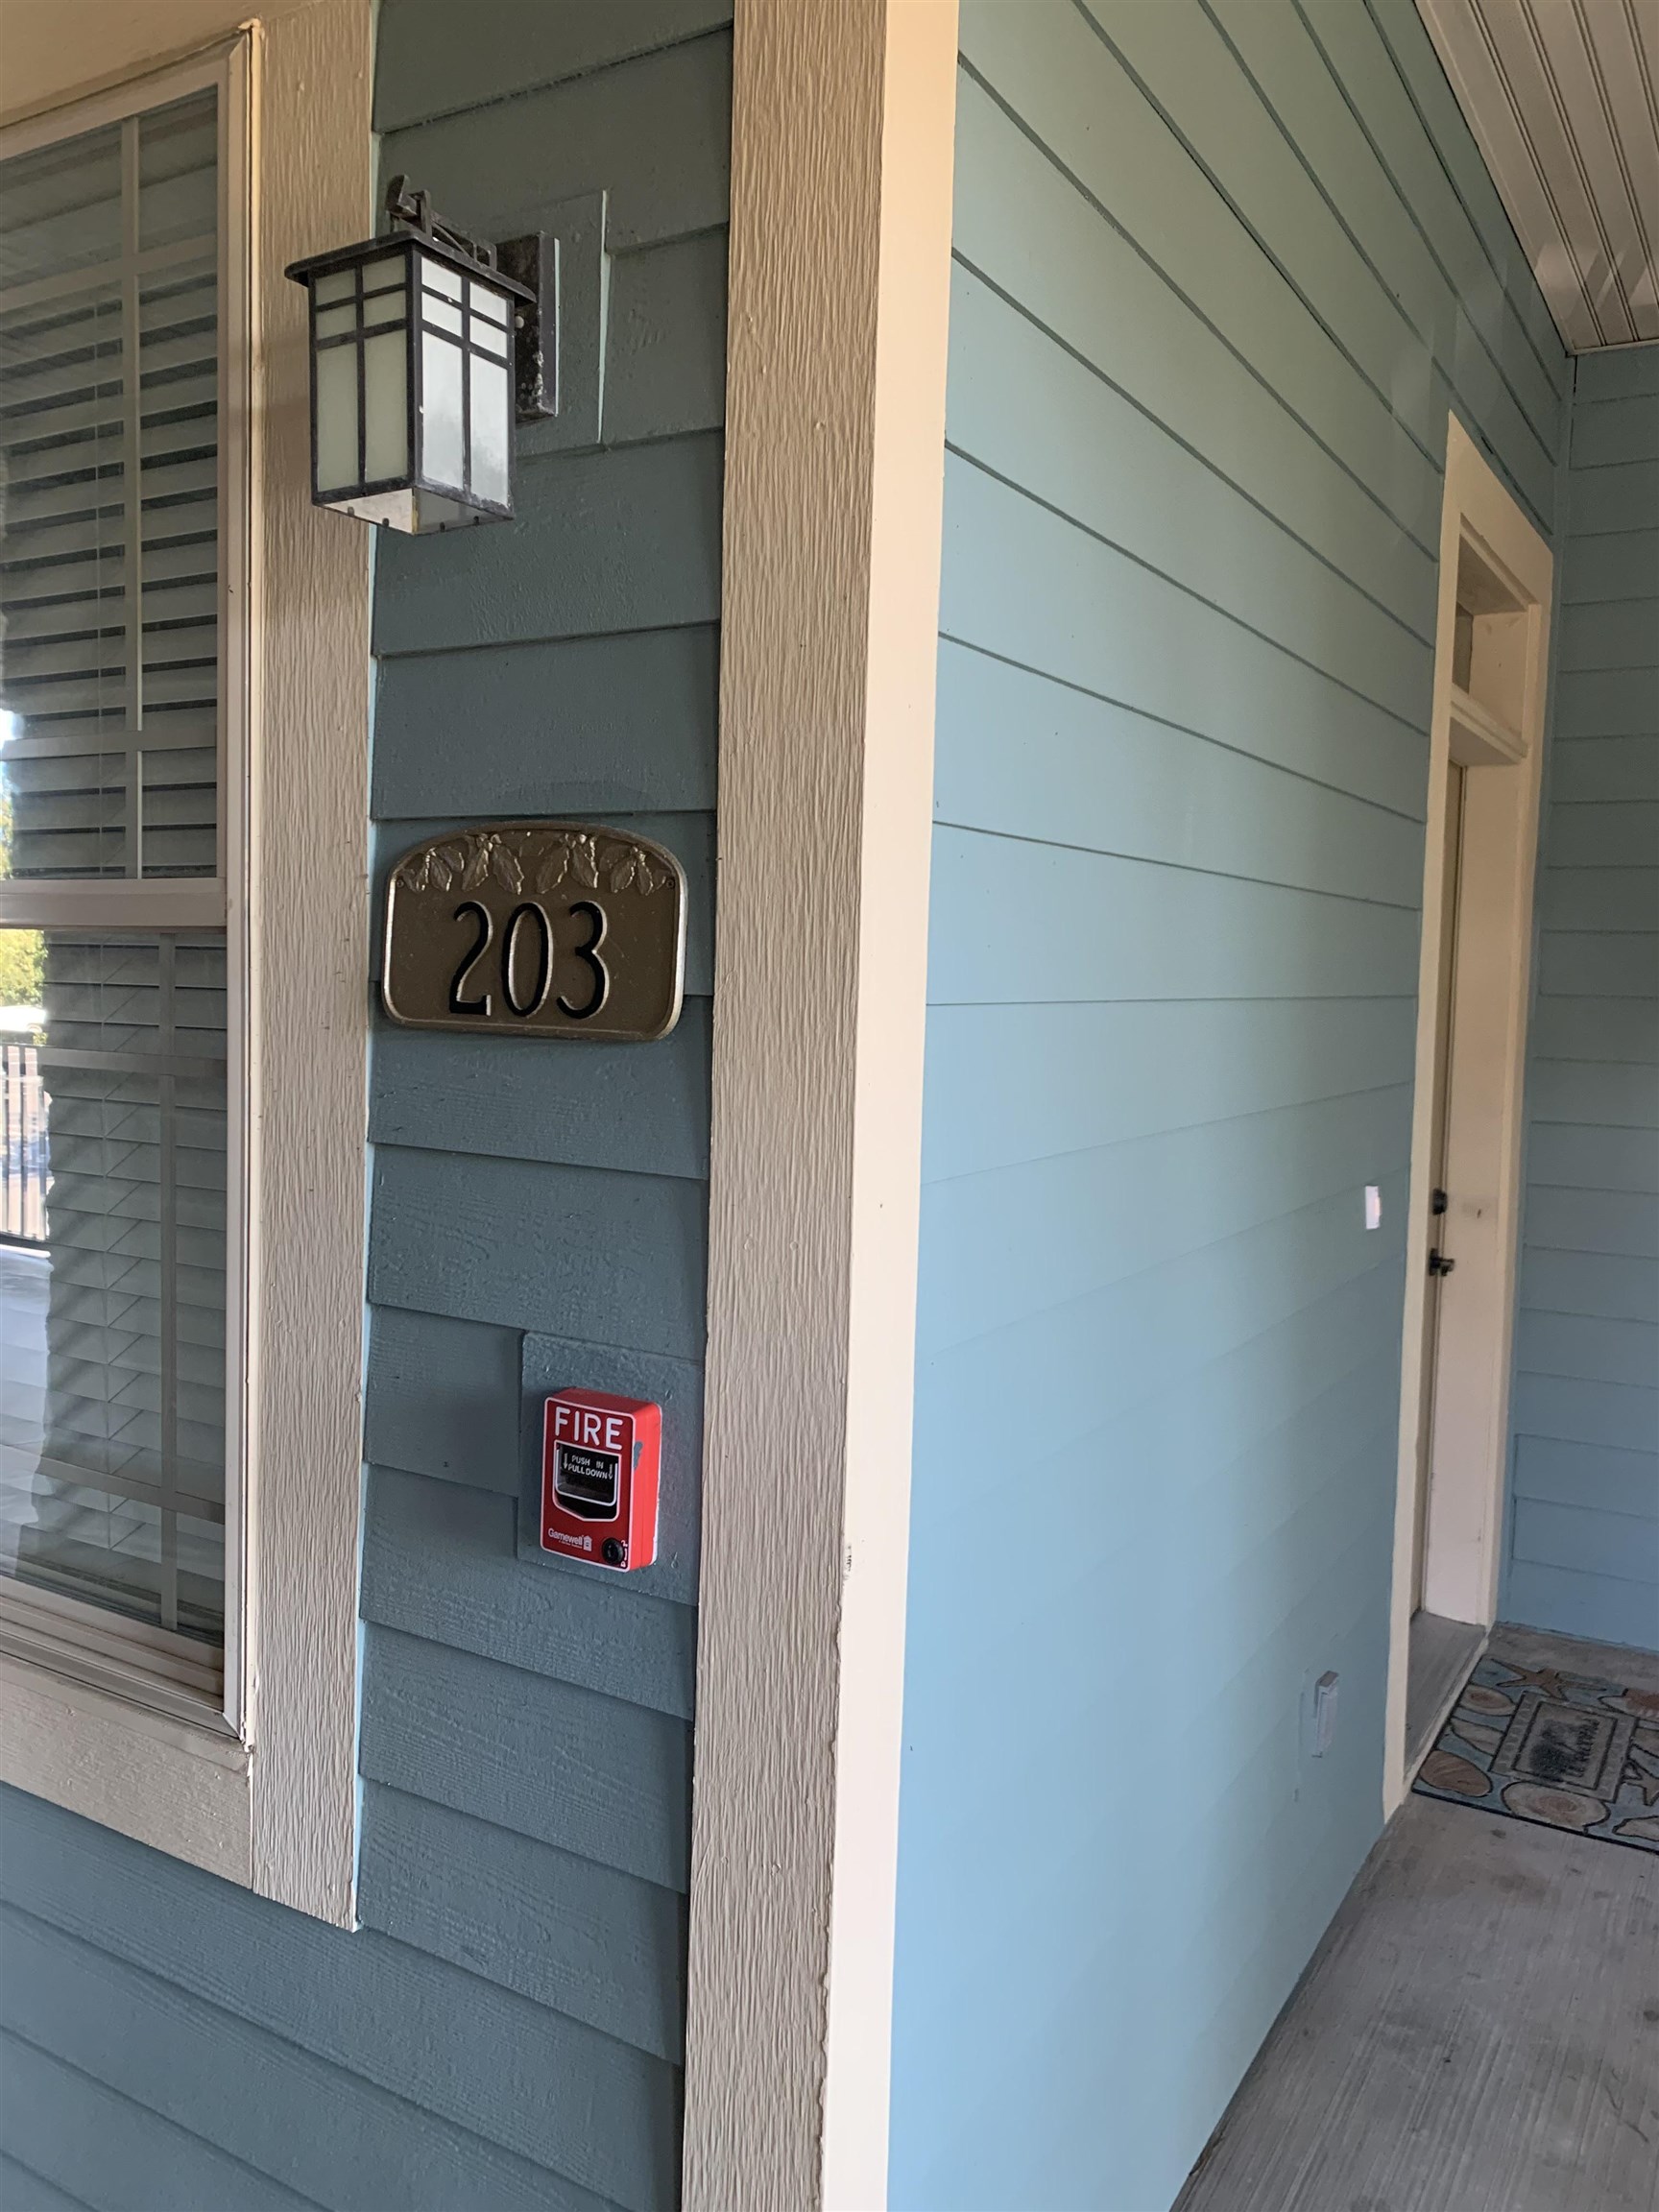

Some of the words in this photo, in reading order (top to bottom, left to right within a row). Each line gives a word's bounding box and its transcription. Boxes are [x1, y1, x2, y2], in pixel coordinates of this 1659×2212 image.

[448, 900, 610, 1021] 203
[554, 1407, 623, 1451] FIRE
[567, 1462, 585, 1475] PULL
[586, 1467, 608, 1479] DOWN
[571, 1455, 590, 1466] PUSH
[595, 1460, 604, 1470] IN
[548, 1527, 583, 1547] Gamewell
